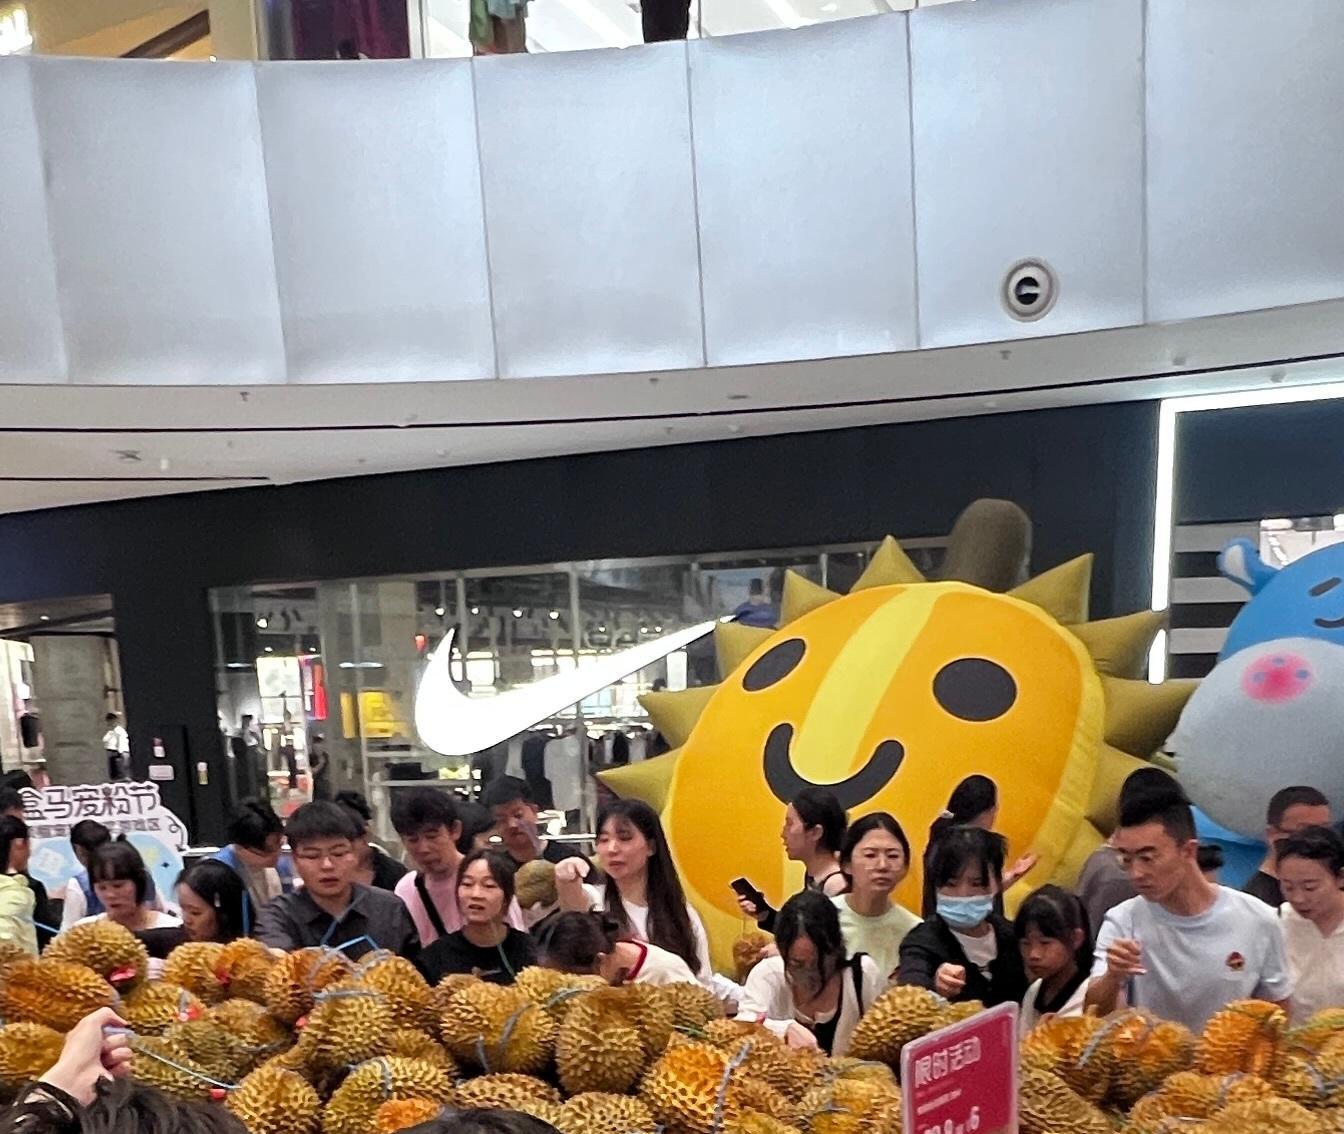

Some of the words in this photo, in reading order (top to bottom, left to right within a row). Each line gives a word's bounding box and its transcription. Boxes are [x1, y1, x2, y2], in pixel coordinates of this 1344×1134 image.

[20, 784, 158, 821] 盒马宠粉节
